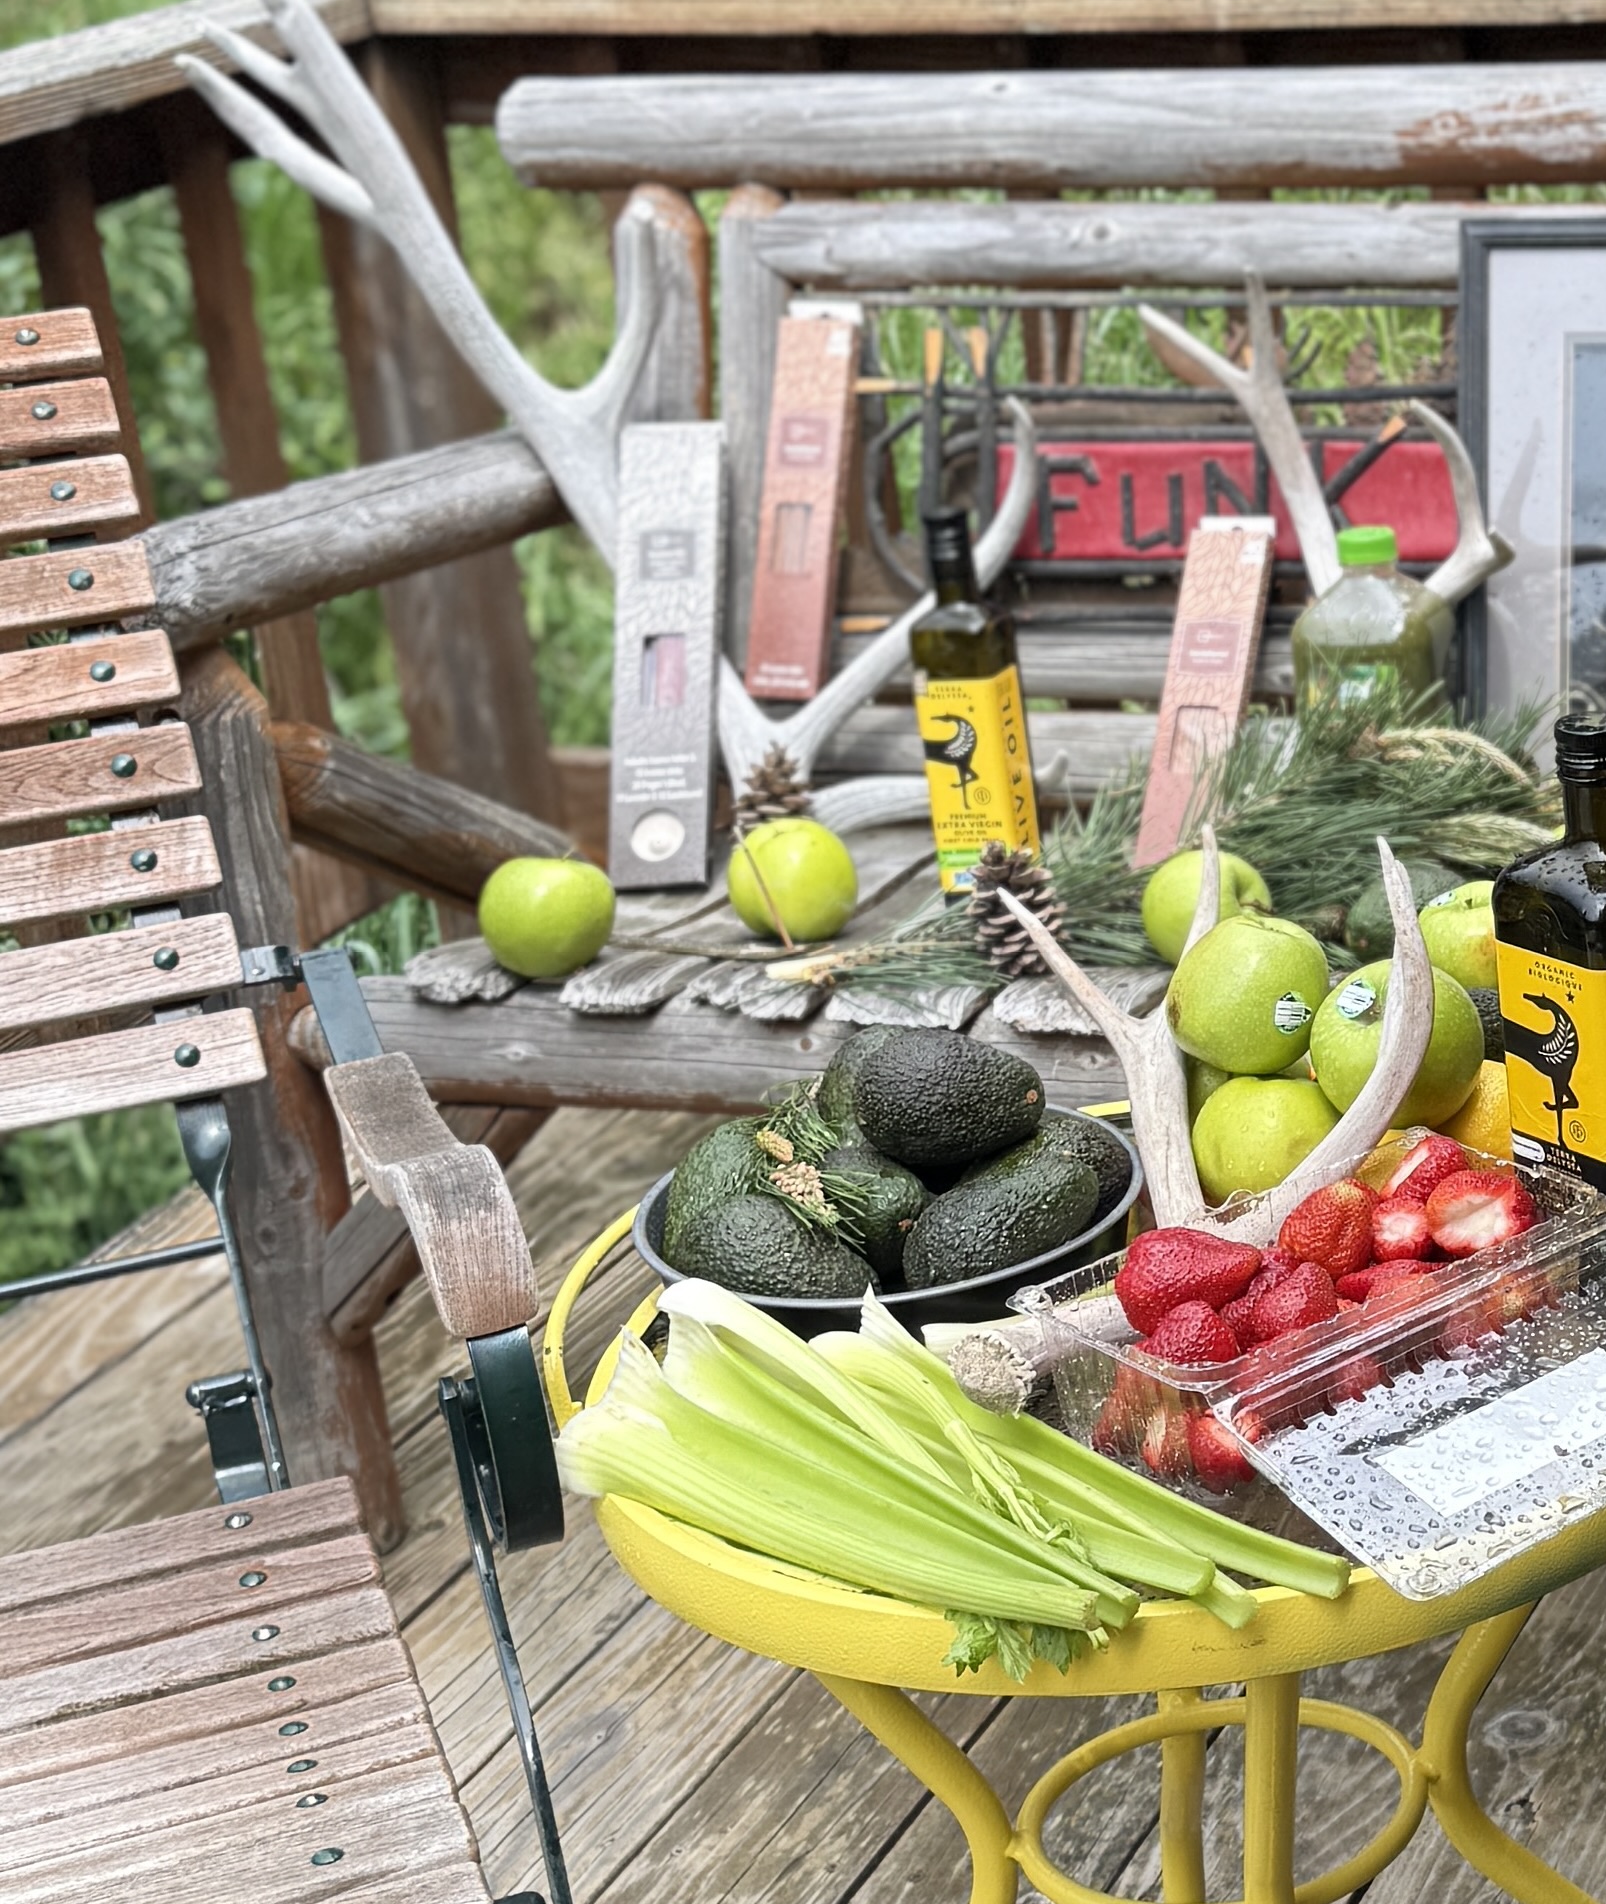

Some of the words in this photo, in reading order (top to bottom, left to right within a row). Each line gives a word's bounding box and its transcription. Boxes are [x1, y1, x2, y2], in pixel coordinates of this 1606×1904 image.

[937, 821, 966, 829] EXTRA
[968, 820, 1002, 828] VIRGIN
[1528, 967, 1582, 991] BIOLOGIQUE
[1534, 961, 1576, 979] ORGANIC
